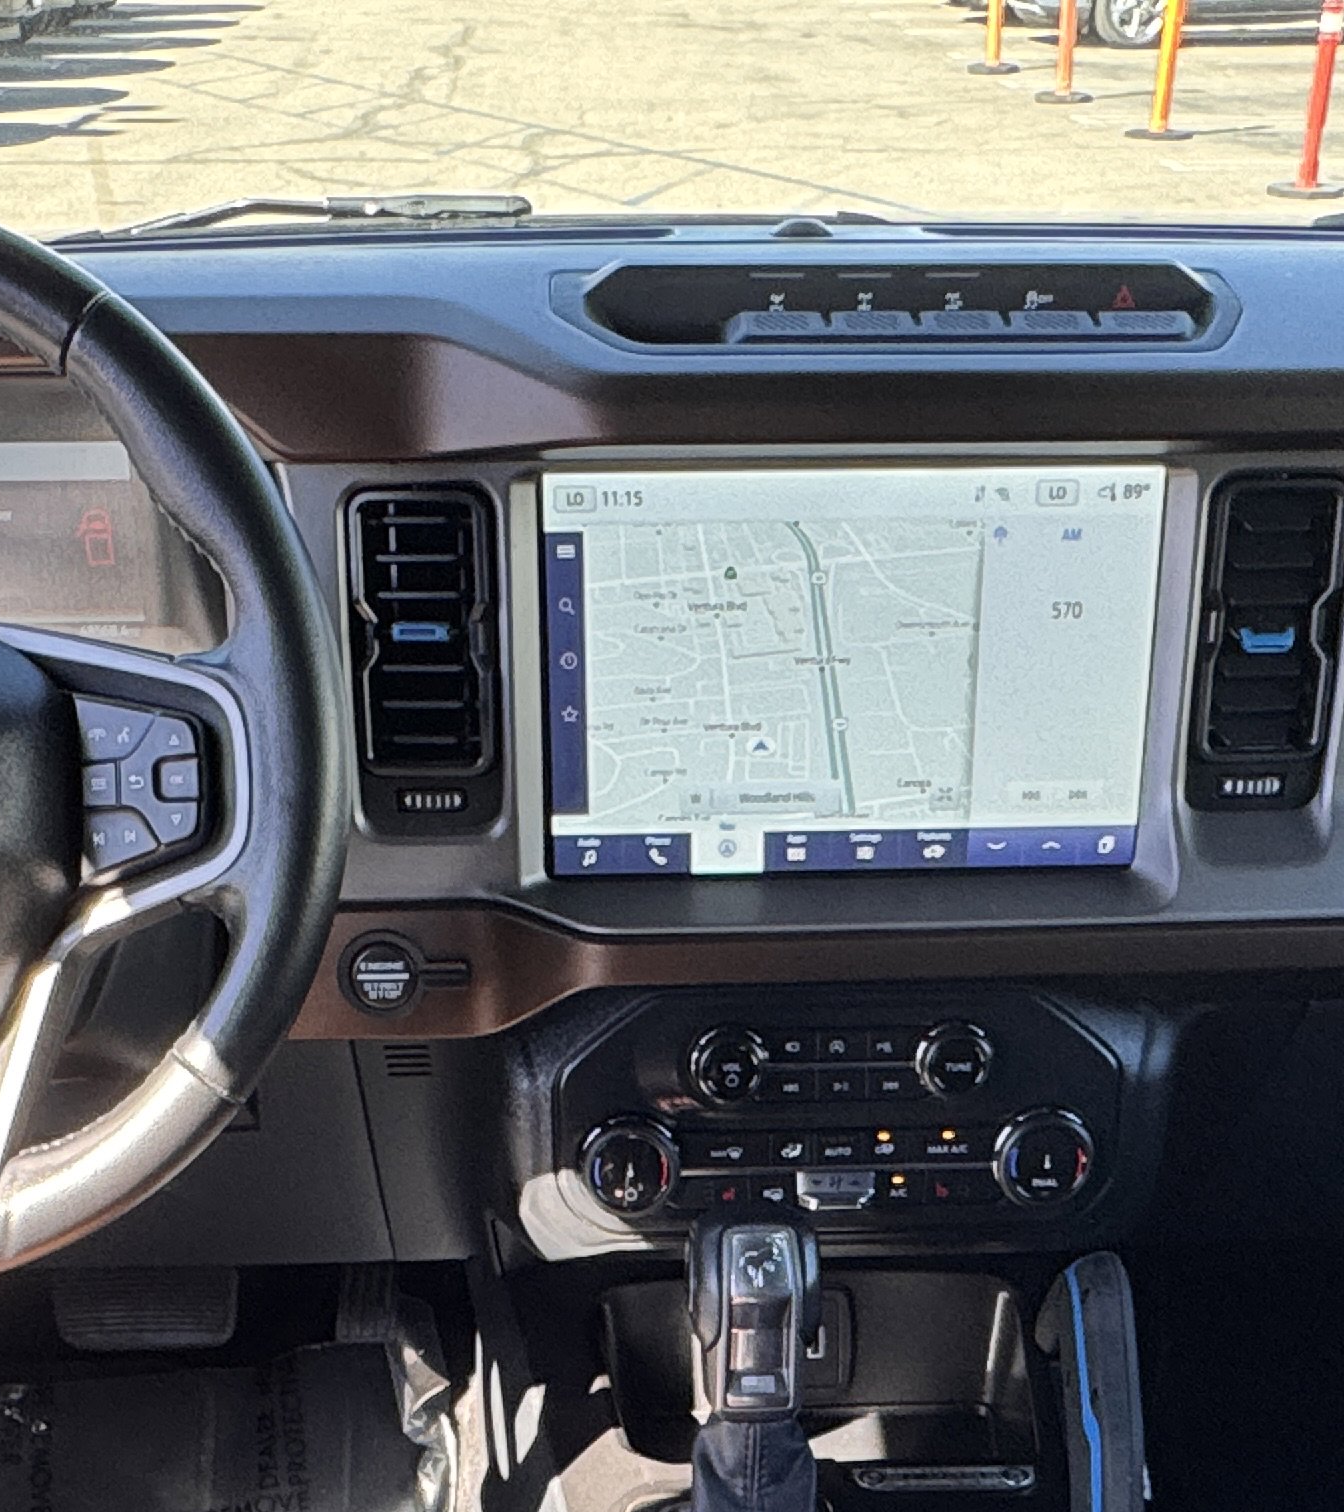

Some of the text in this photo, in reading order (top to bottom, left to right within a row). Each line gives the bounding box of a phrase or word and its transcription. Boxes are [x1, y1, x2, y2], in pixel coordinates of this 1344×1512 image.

[566, 490, 644, 507] LO 11:15
[1049, 486, 1067, 500] LO
[1122, 484, 1151, 500] 89°
[1062, 529, 1083, 540] AM
[1051, 601, 1084, 620] 570
[927, 1144, 949, 1154] MAX
